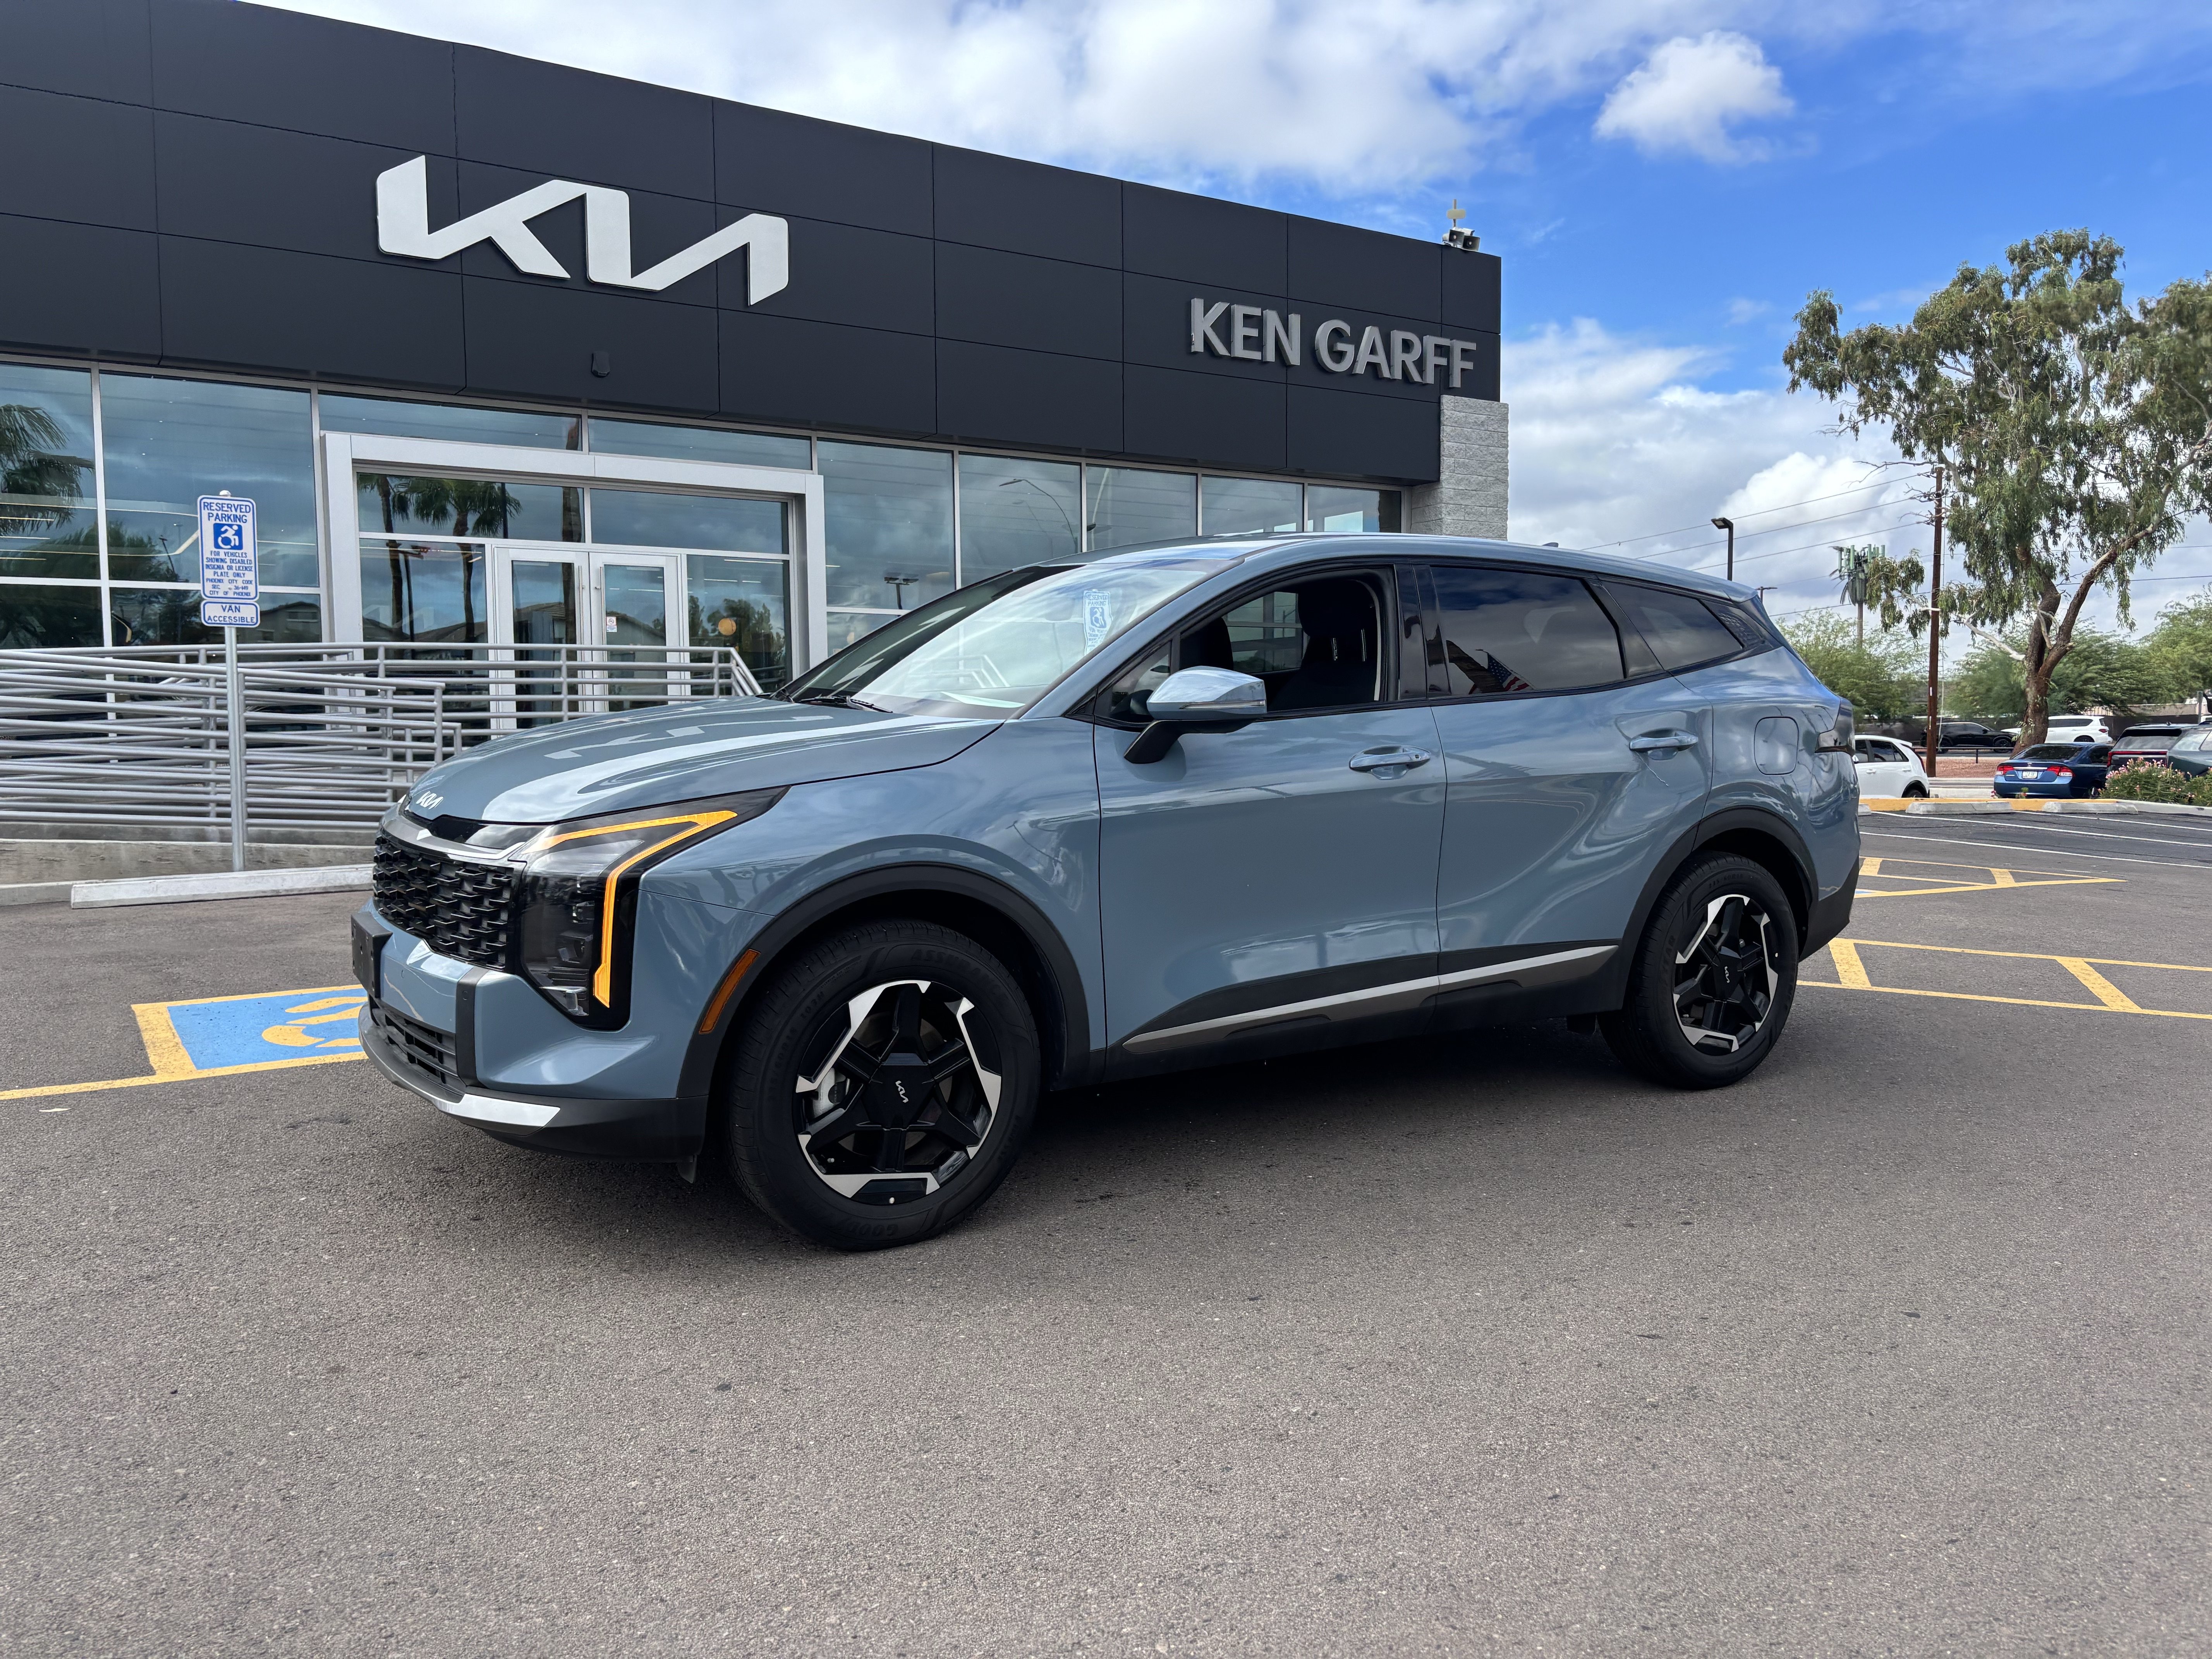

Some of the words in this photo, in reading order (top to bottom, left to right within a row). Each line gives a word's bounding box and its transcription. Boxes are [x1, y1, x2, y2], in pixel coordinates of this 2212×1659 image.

[376, 155, 788, 306] KIA
[1191, 298, 1301, 366] KEN
[1314, 319, 1476, 388] GARFF
[203, 502, 251, 513] RESERVED
[208, 512, 247, 523] PARKING
[207, 615, 255, 623] ACCESSIBLE
